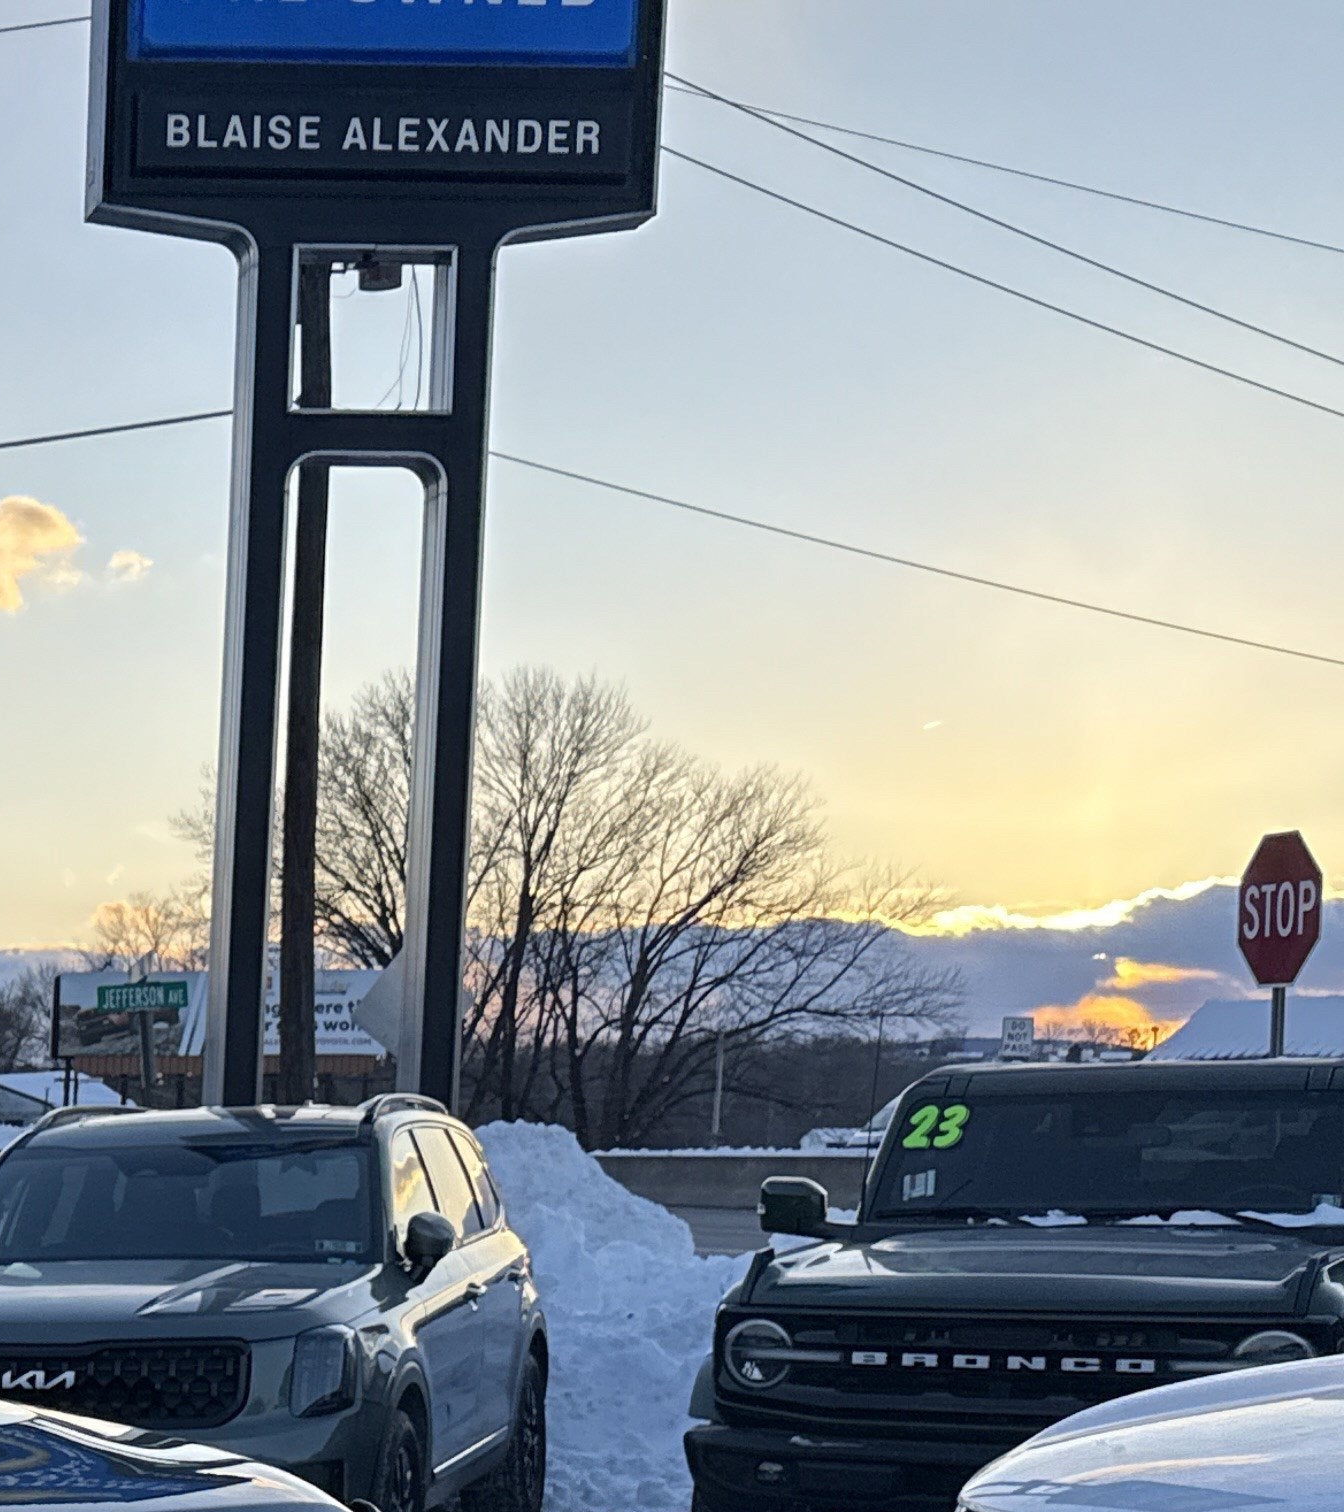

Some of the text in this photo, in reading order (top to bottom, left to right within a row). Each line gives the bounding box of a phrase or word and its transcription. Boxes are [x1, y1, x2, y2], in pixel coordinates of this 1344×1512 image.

[165, 113, 601, 155] BLAISE ALEXANDER
[1242, 879, 1317, 940] STOP
[102, 986, 165, 1009] JEFFERSON
[902, 1104, 970, 1149] 23
[851, 1350, 1157, 1375] BRONCO
